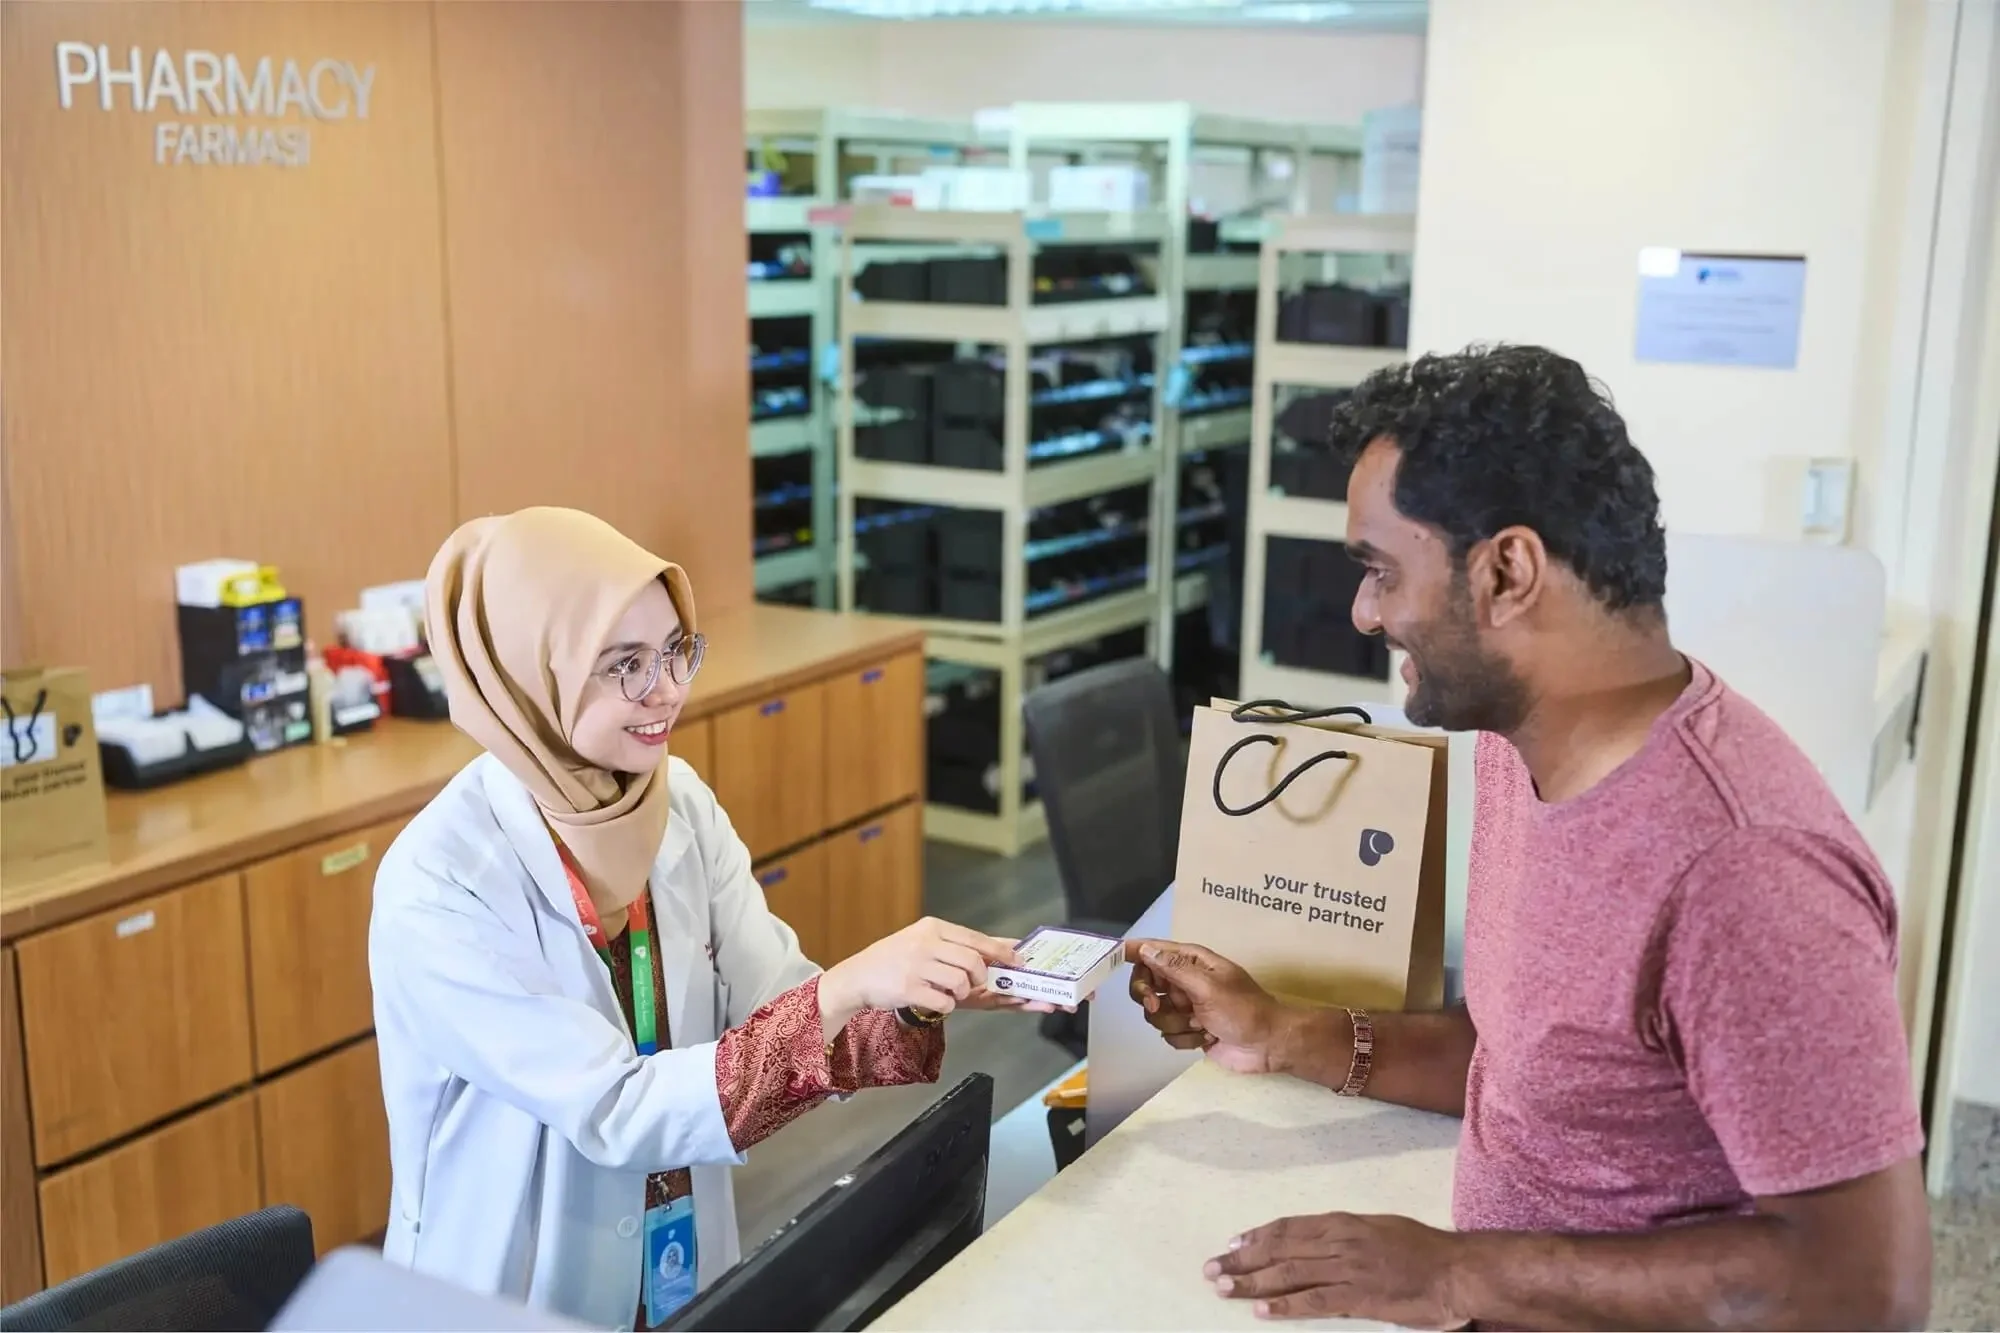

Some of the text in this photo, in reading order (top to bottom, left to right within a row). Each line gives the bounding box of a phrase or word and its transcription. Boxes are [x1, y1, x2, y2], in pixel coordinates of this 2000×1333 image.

[56, 42, 376, 121] PHARMACY
[156, 121, 311, 167] FARMASI
[1201, 877, 1384, 934] healthcare partner
[1263, 873, 1387, 913] your trusted
